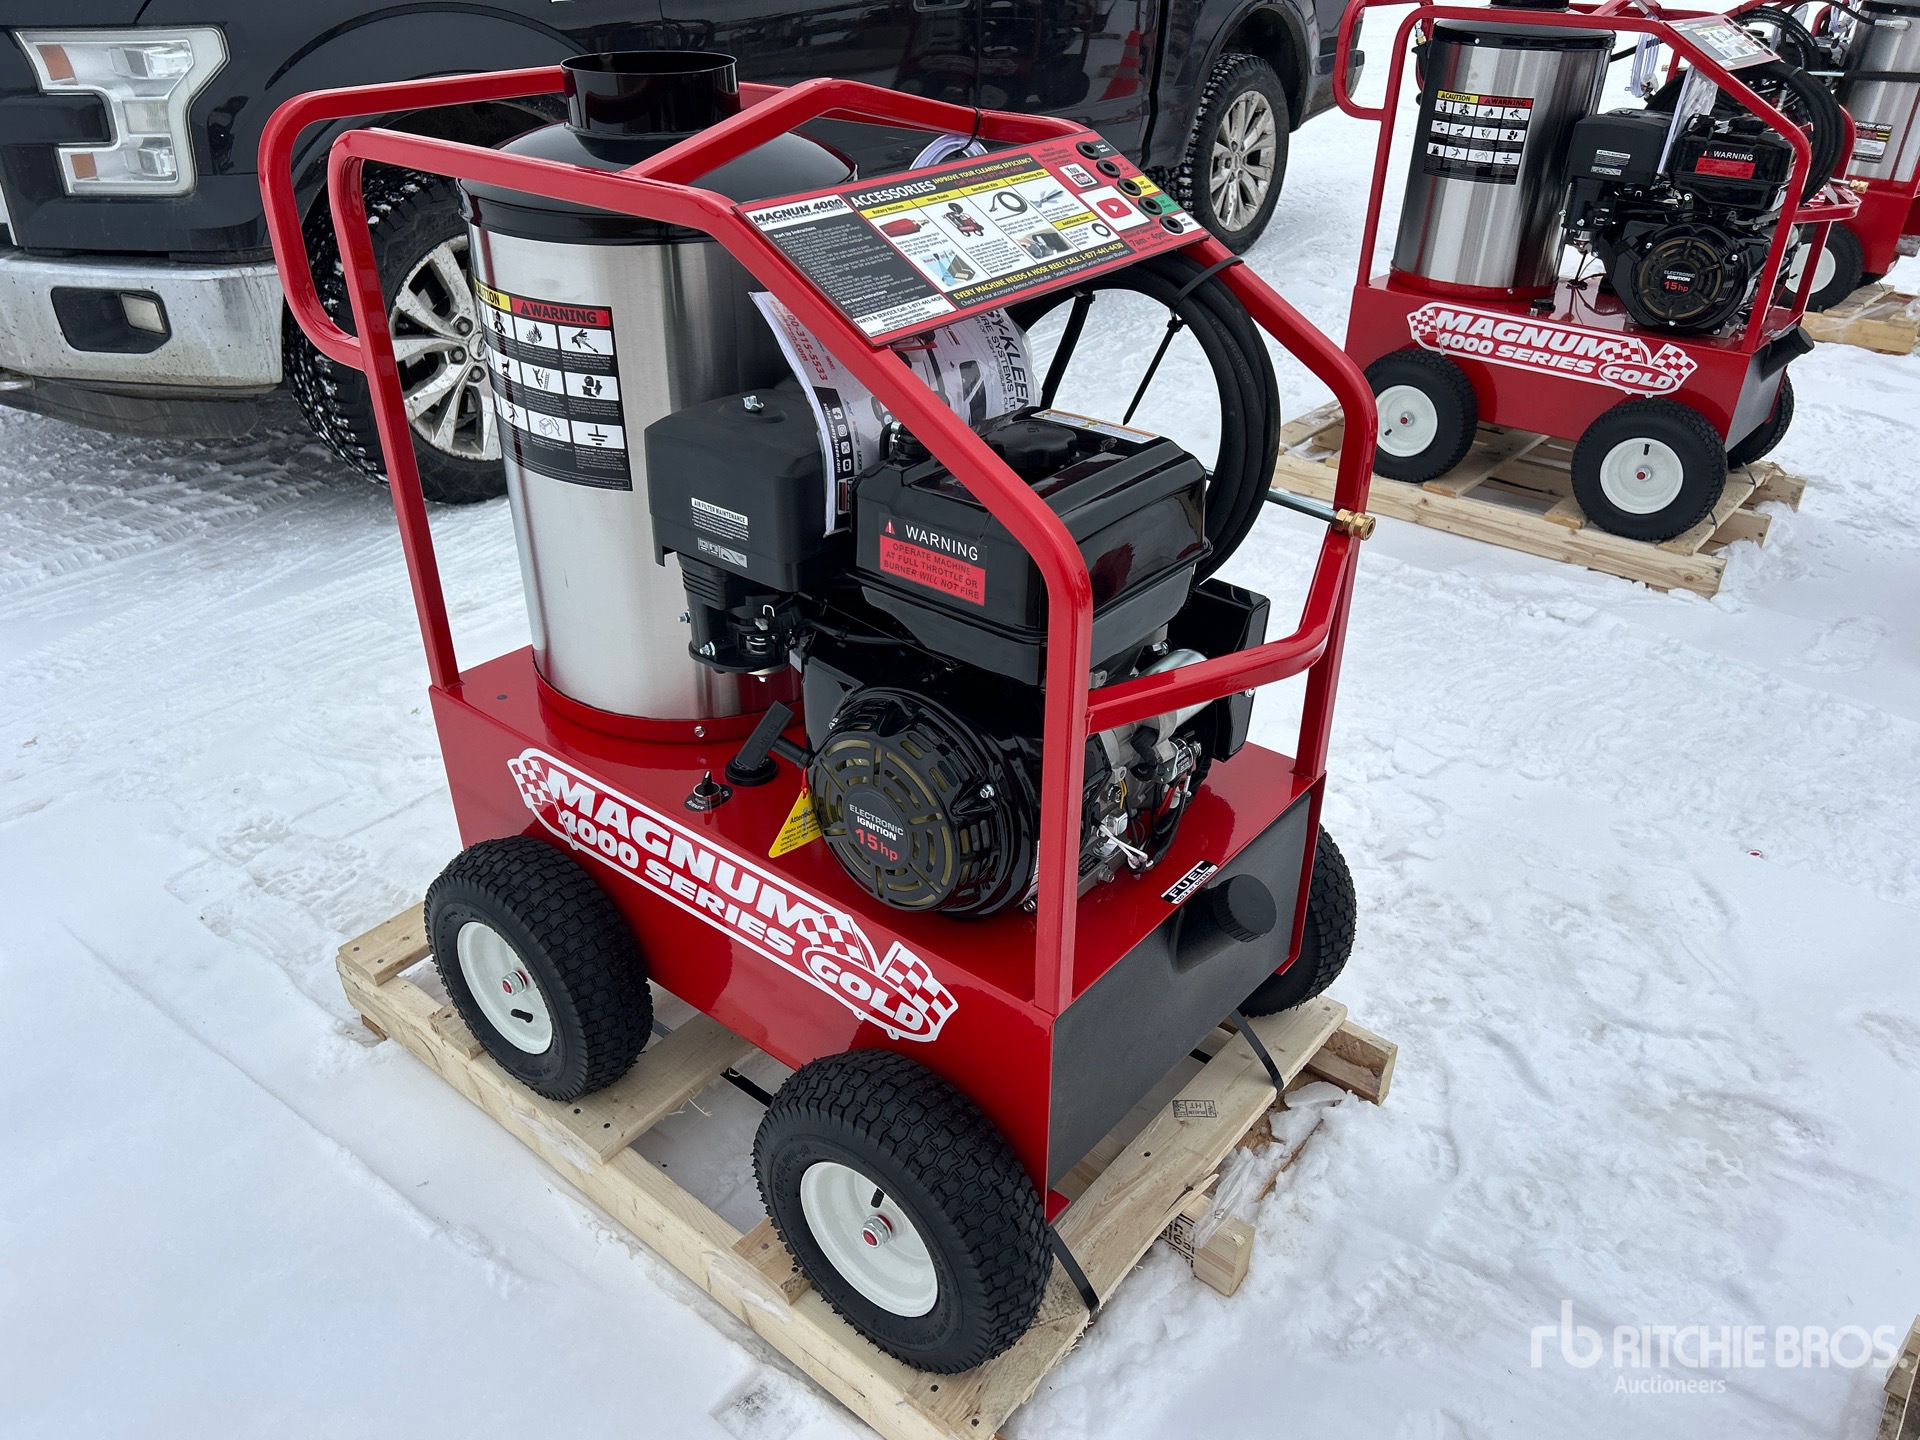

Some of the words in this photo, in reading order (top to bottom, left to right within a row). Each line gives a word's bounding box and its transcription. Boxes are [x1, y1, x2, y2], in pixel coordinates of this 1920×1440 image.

[1446, 92, 1471, 102] CAUTION
[1492, 98, 1526, 107] WARNING
[1713, 150, 1754, 161] WARNING
[932, 173, 959, 183] IMPROVE
[974, 164, 1002, 174] CLEANING
[1001, 157, 1033, 168] EFFICIENCY
[1066, 165, 1078, 174] You
[1075, 174, 1089, 183] Tube
[850, 180, 935, 207] ACCESSORIES
[752, 204, 811, 223] MAGNUM
[812, 197, 843, 211] 4000
[1129, 236, 1146, 246] 7am
[1150, 230, 1167, 240] 4pm
[954, 288, 976, 299] EVERY
[975, 279, 1006, 292] MACHINE
[1005, 272, 1027, 283] NEEDS
[1032, 265, 1049, 275] HOSE
[1048, 260, 1066, 270] REEL!
[1064, 255, 1081, 264] CALL
[1079, 242, 1124, 260] 1-877-441-4430
[1664, 270, 1695, 278] ELECTRONIC
[530, 304, 597, 324] WARNING
[961, 297, 975, 306] Check
[857, 316, 872, 324] PARTS
[877, 309, 896, 318] SERVICE
[1438, 310, 1613, 358] MAGNUM
[992, 335, 1014, 392] SYSTEMS
[1436, 334, 1494, 354] 4000
[1495, 343, 1596, 373] SERIES
[1603, 367, 1674, 388] GOLD
[822, 403, 841, 473] sales@easykleen.com
[701, 502, 715, 512] FILTER
[715, 506, 746, 523] MAINTENANCE
[906, 524, 978, 561] WARNING
[886, 551, 895, 559] AT
[898, 555, 918, 567] FULL
[922, 560, 963, 582] THROTTLE
[966, 578, 977, 588] OR
[893, 543, 931, 561] OPERATE
[934, 556, 971, 576] MACHINE
[884, 560, 917, 577] BURNER
[920, 572, 937, 585] WILL
[941, 580, 959, 590] NOT
[960, 588, 979, 599] FIRE
[850, 804, 904, 836] ELECTRONIC
[857, 816, 897, 841] IGNITION
[546, 768, 822, 937] MAGNUM
[558, 810, 639, 869] 4000
[645, 859, 796, 956] SERIES
[1169, 866, 1209, 898] FUEL
[1195, 871, 1212, 886] DIESEL
[809, 955, 923, 1031] GOLD
